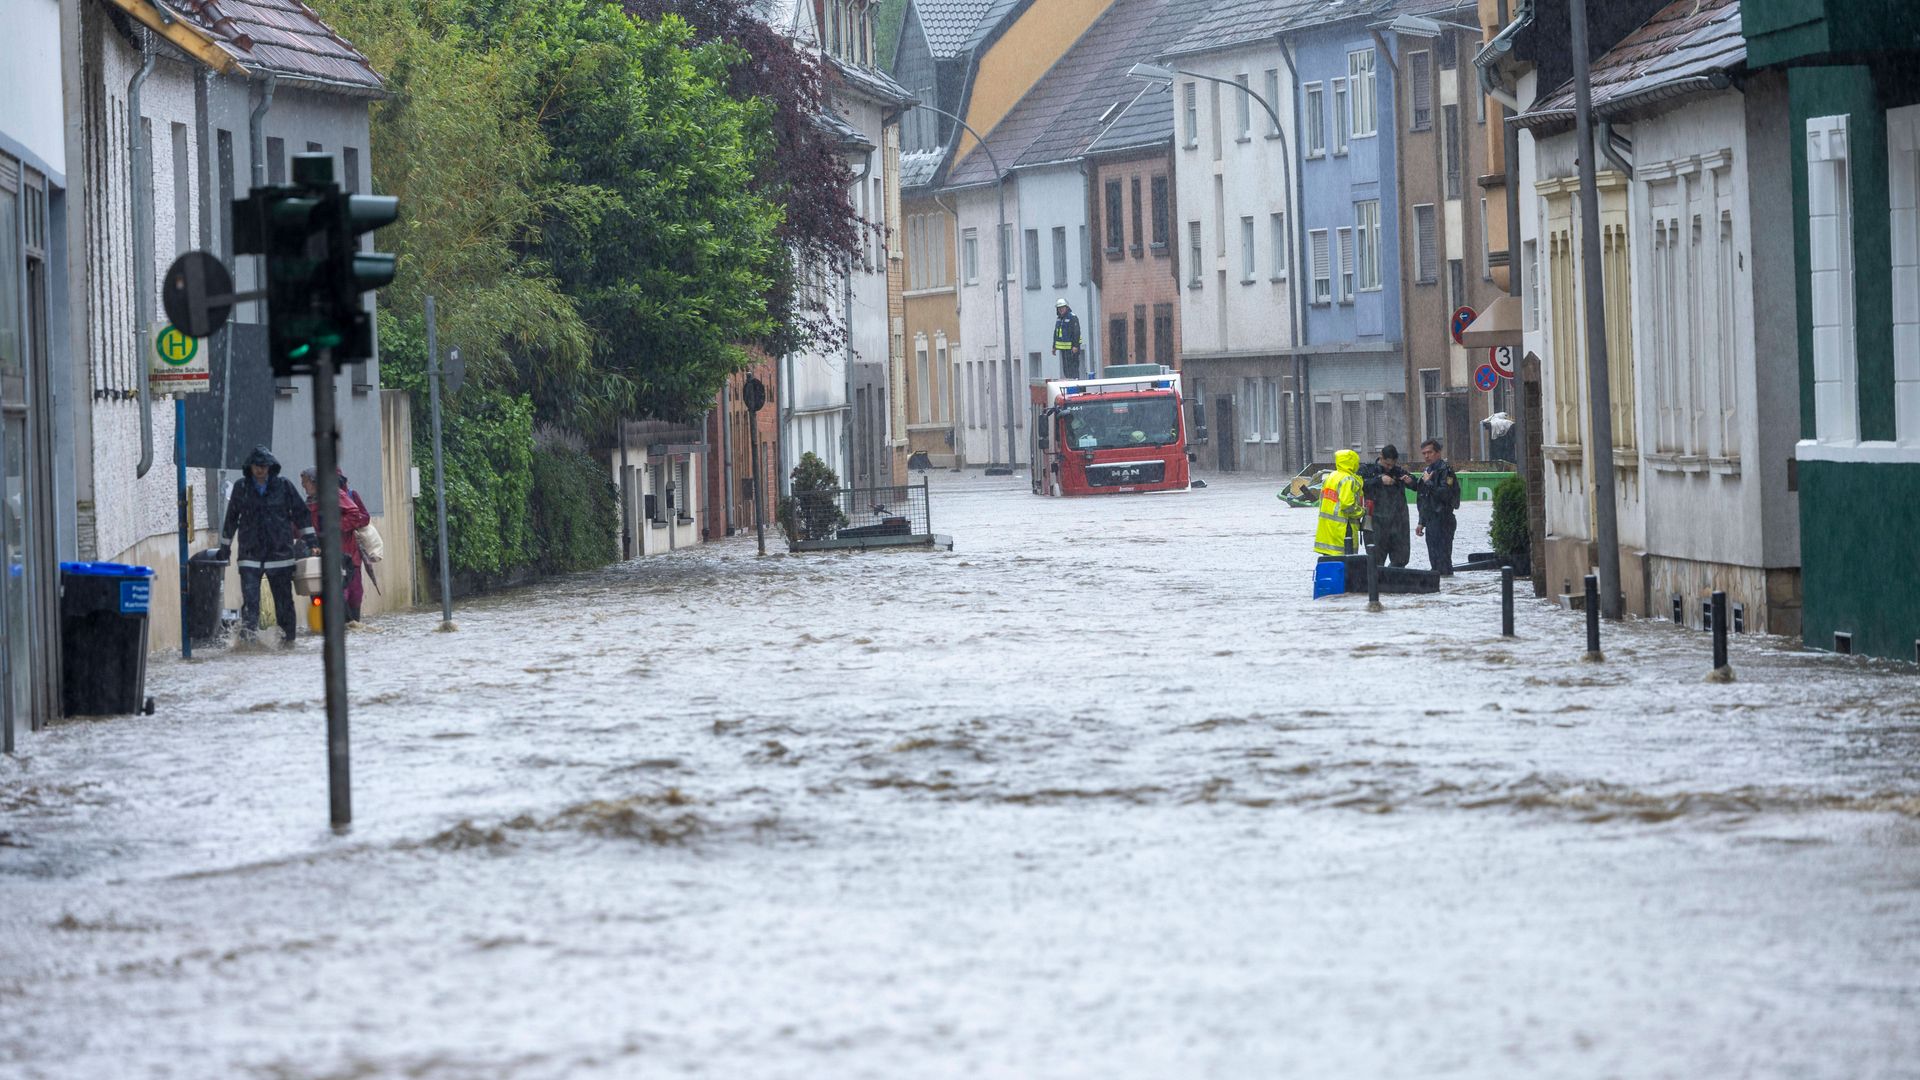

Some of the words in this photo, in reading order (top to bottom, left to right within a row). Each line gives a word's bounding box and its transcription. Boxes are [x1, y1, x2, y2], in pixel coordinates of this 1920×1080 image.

[169, 334, 186, 356] H
[1498, 346, 1511, 367] 3
[1111, 469, 1140, 477] MAN
